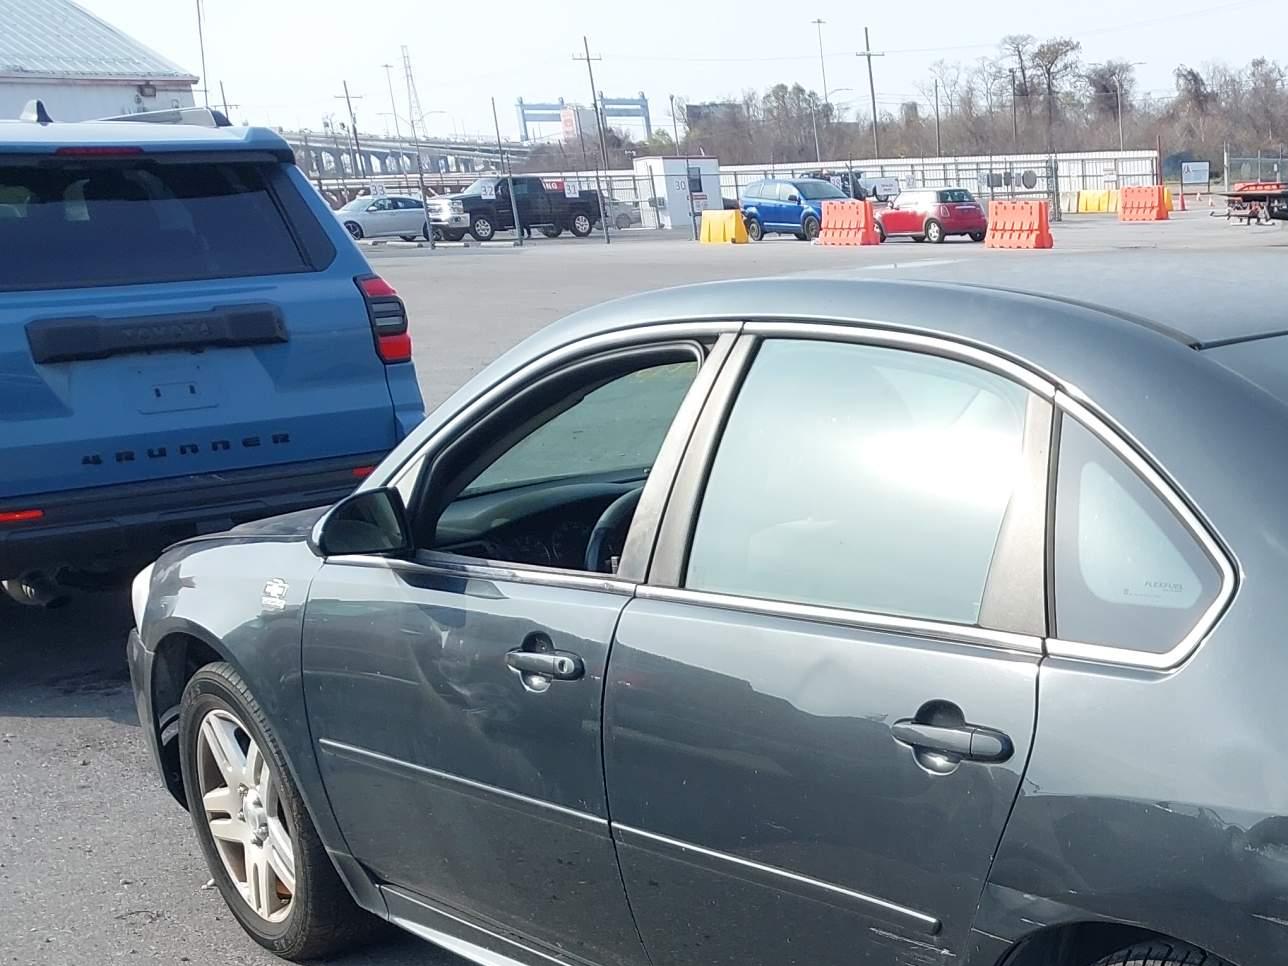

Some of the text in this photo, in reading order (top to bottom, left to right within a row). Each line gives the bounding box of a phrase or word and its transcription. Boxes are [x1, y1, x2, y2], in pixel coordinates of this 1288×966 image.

[481, 184, 495, 196] 32
[566, 183, 577, 195] 31
[675, 180, 686, 191] 30
[81, 432, 291, 466] 4RUNNER
